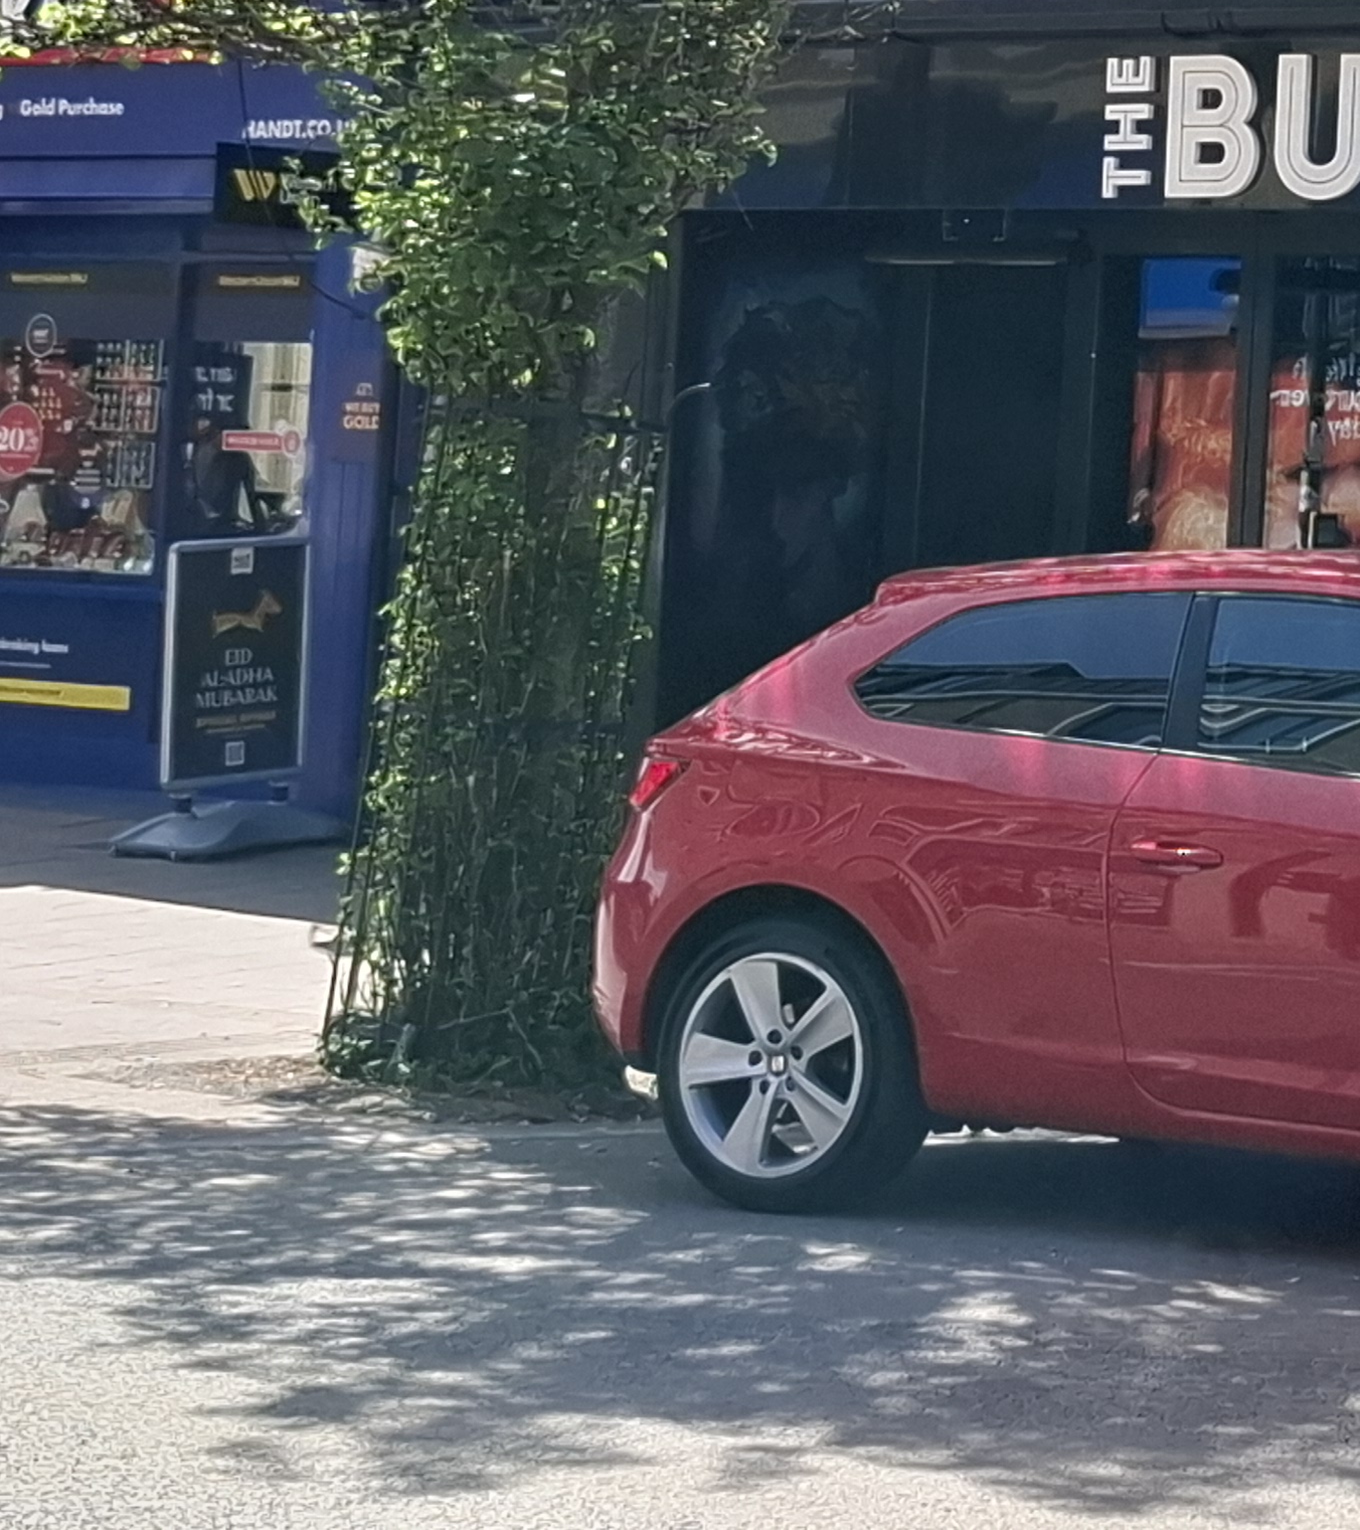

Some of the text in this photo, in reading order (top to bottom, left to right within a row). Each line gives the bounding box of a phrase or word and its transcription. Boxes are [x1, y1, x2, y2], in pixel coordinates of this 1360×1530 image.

[20, 97, 56, 116] Gold
[58, 97, 125, 116] Purchase
[1102, 55, 1156, 199] THE
[343, 415, 380, 431] GOLD
[224, 647, 254, 667] EID
[195, 685, 279, 709] MUBARAK
